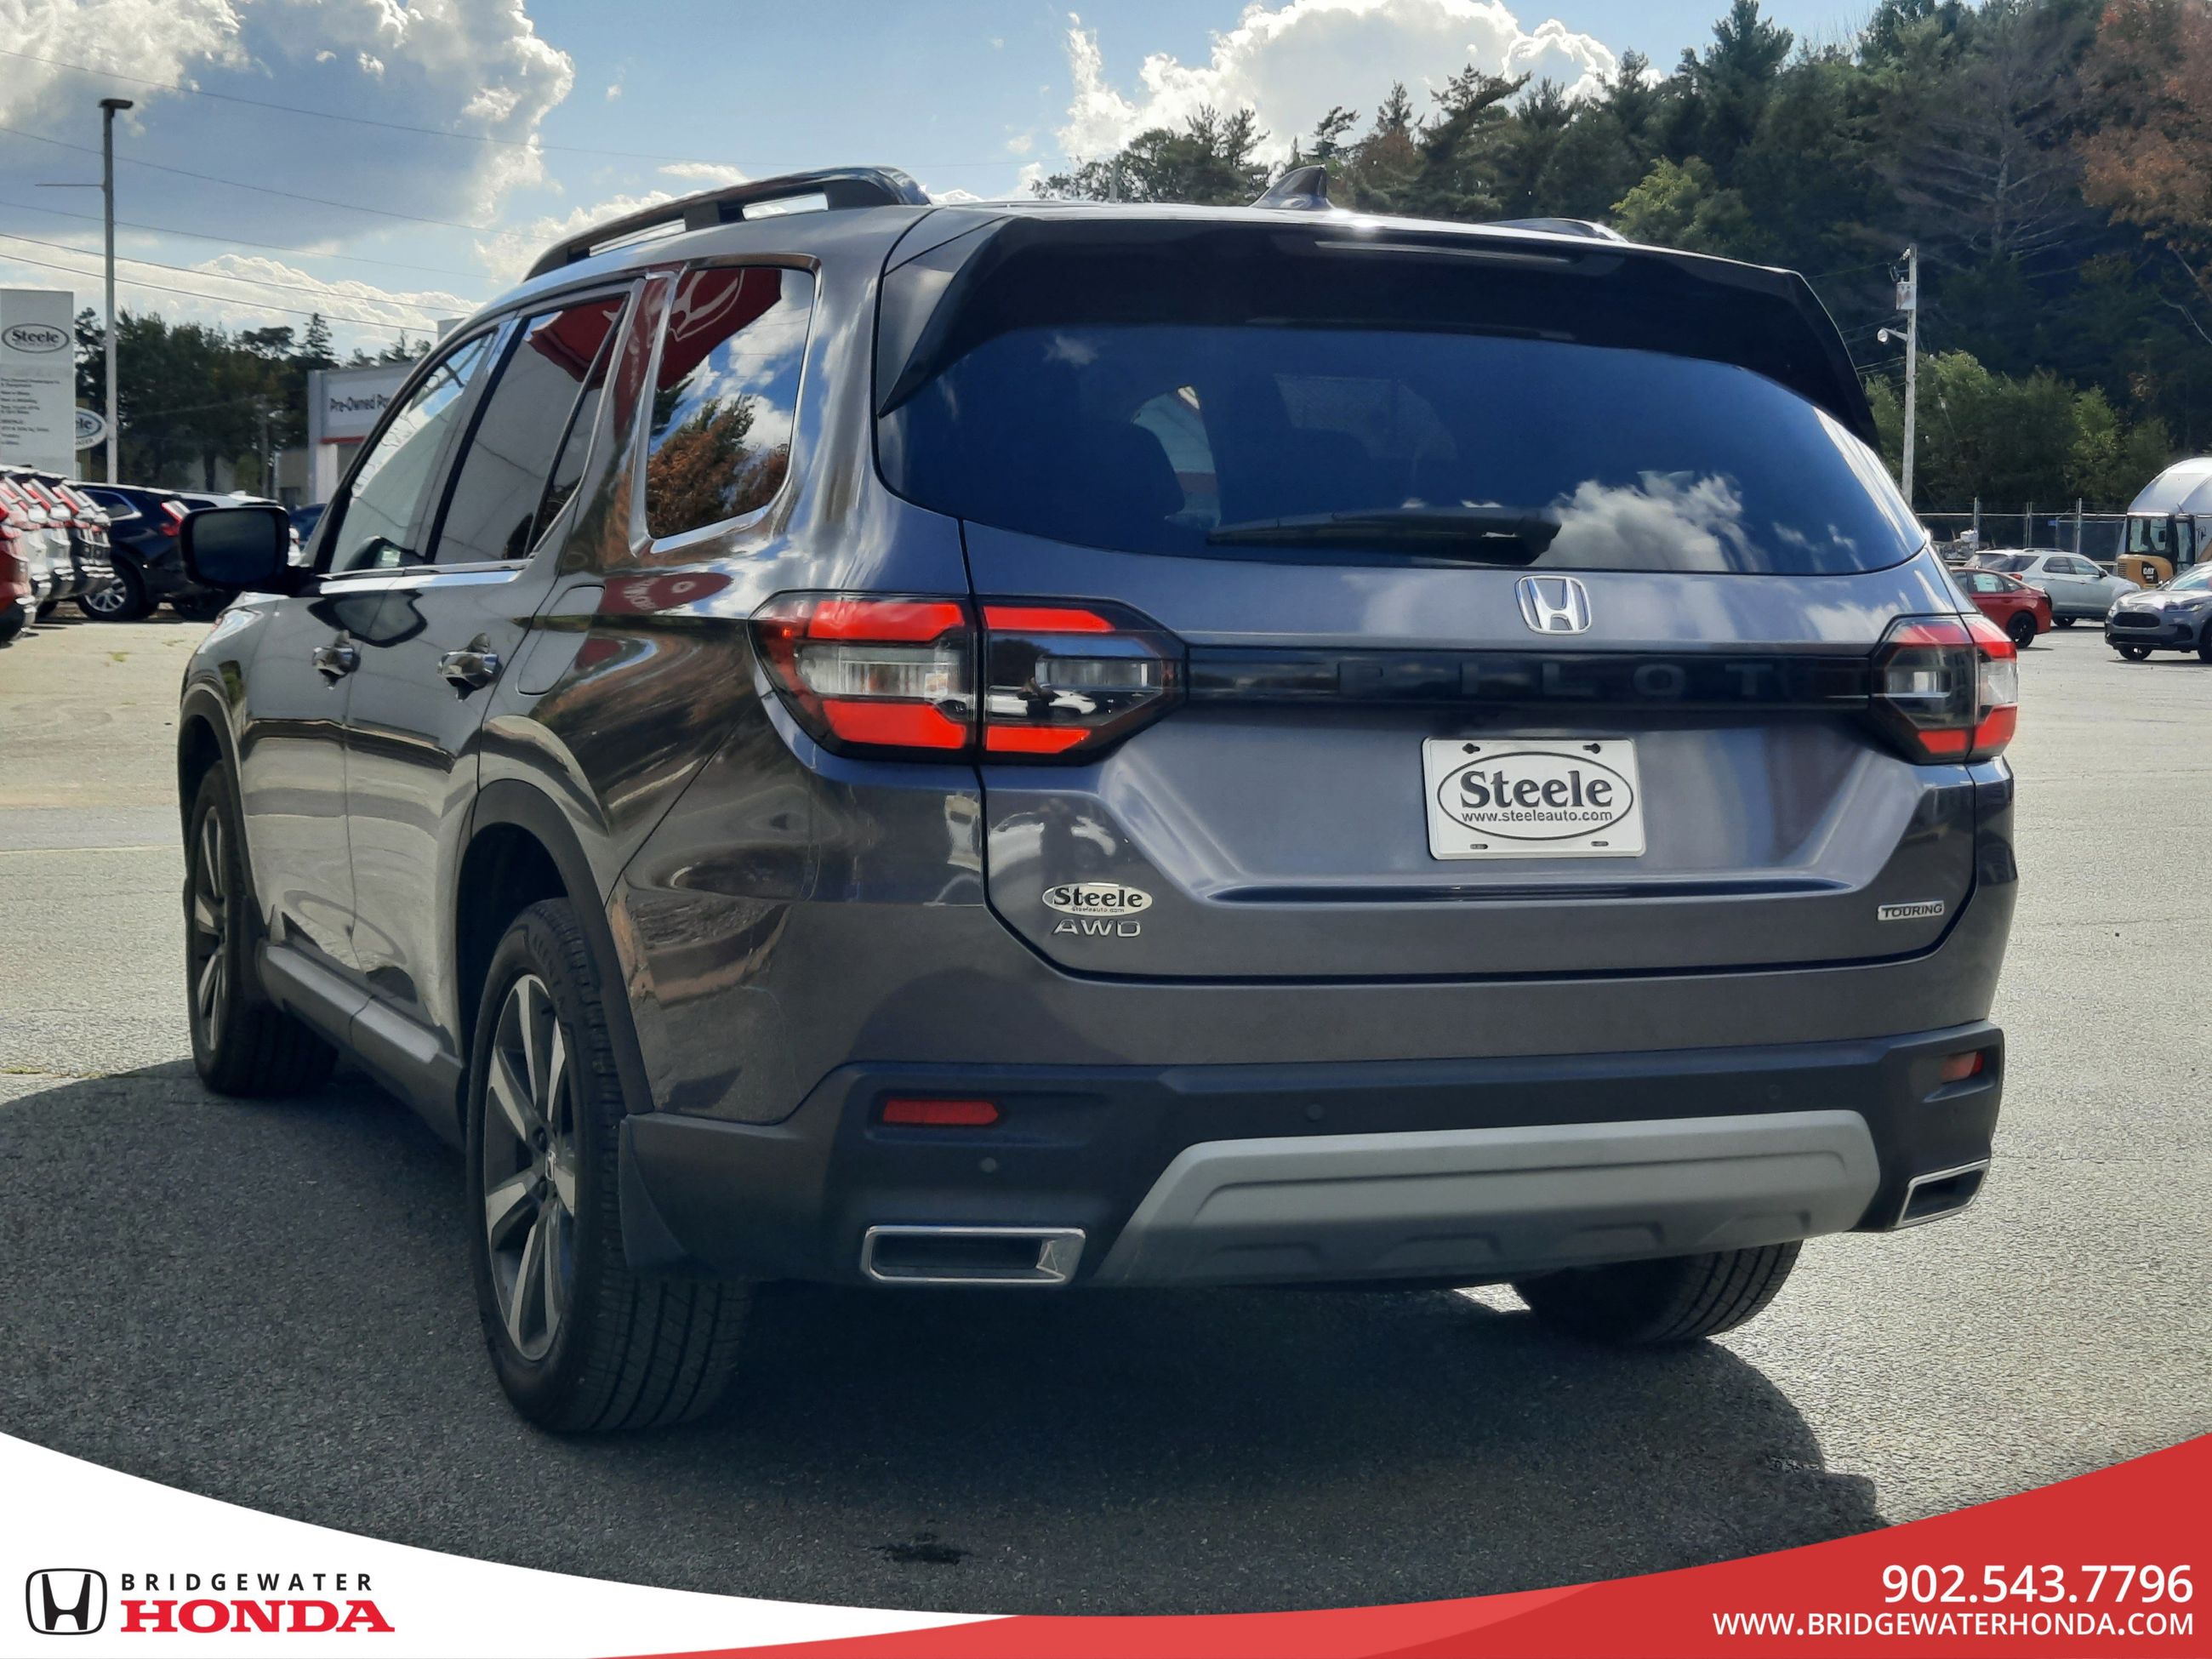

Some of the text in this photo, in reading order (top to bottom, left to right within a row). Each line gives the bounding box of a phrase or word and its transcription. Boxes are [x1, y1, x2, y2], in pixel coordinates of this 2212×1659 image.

[12, 328, 60, 343] Steele
[1460, 769, 1613, 808] Steele
[1461, 810, 1613, 823] www.steeleauto.com
[1053, 887, 1143, 908] Steele
[1882, 904, 1942, 918] TOURING
[1052, 918, 1142, 938] AWD
